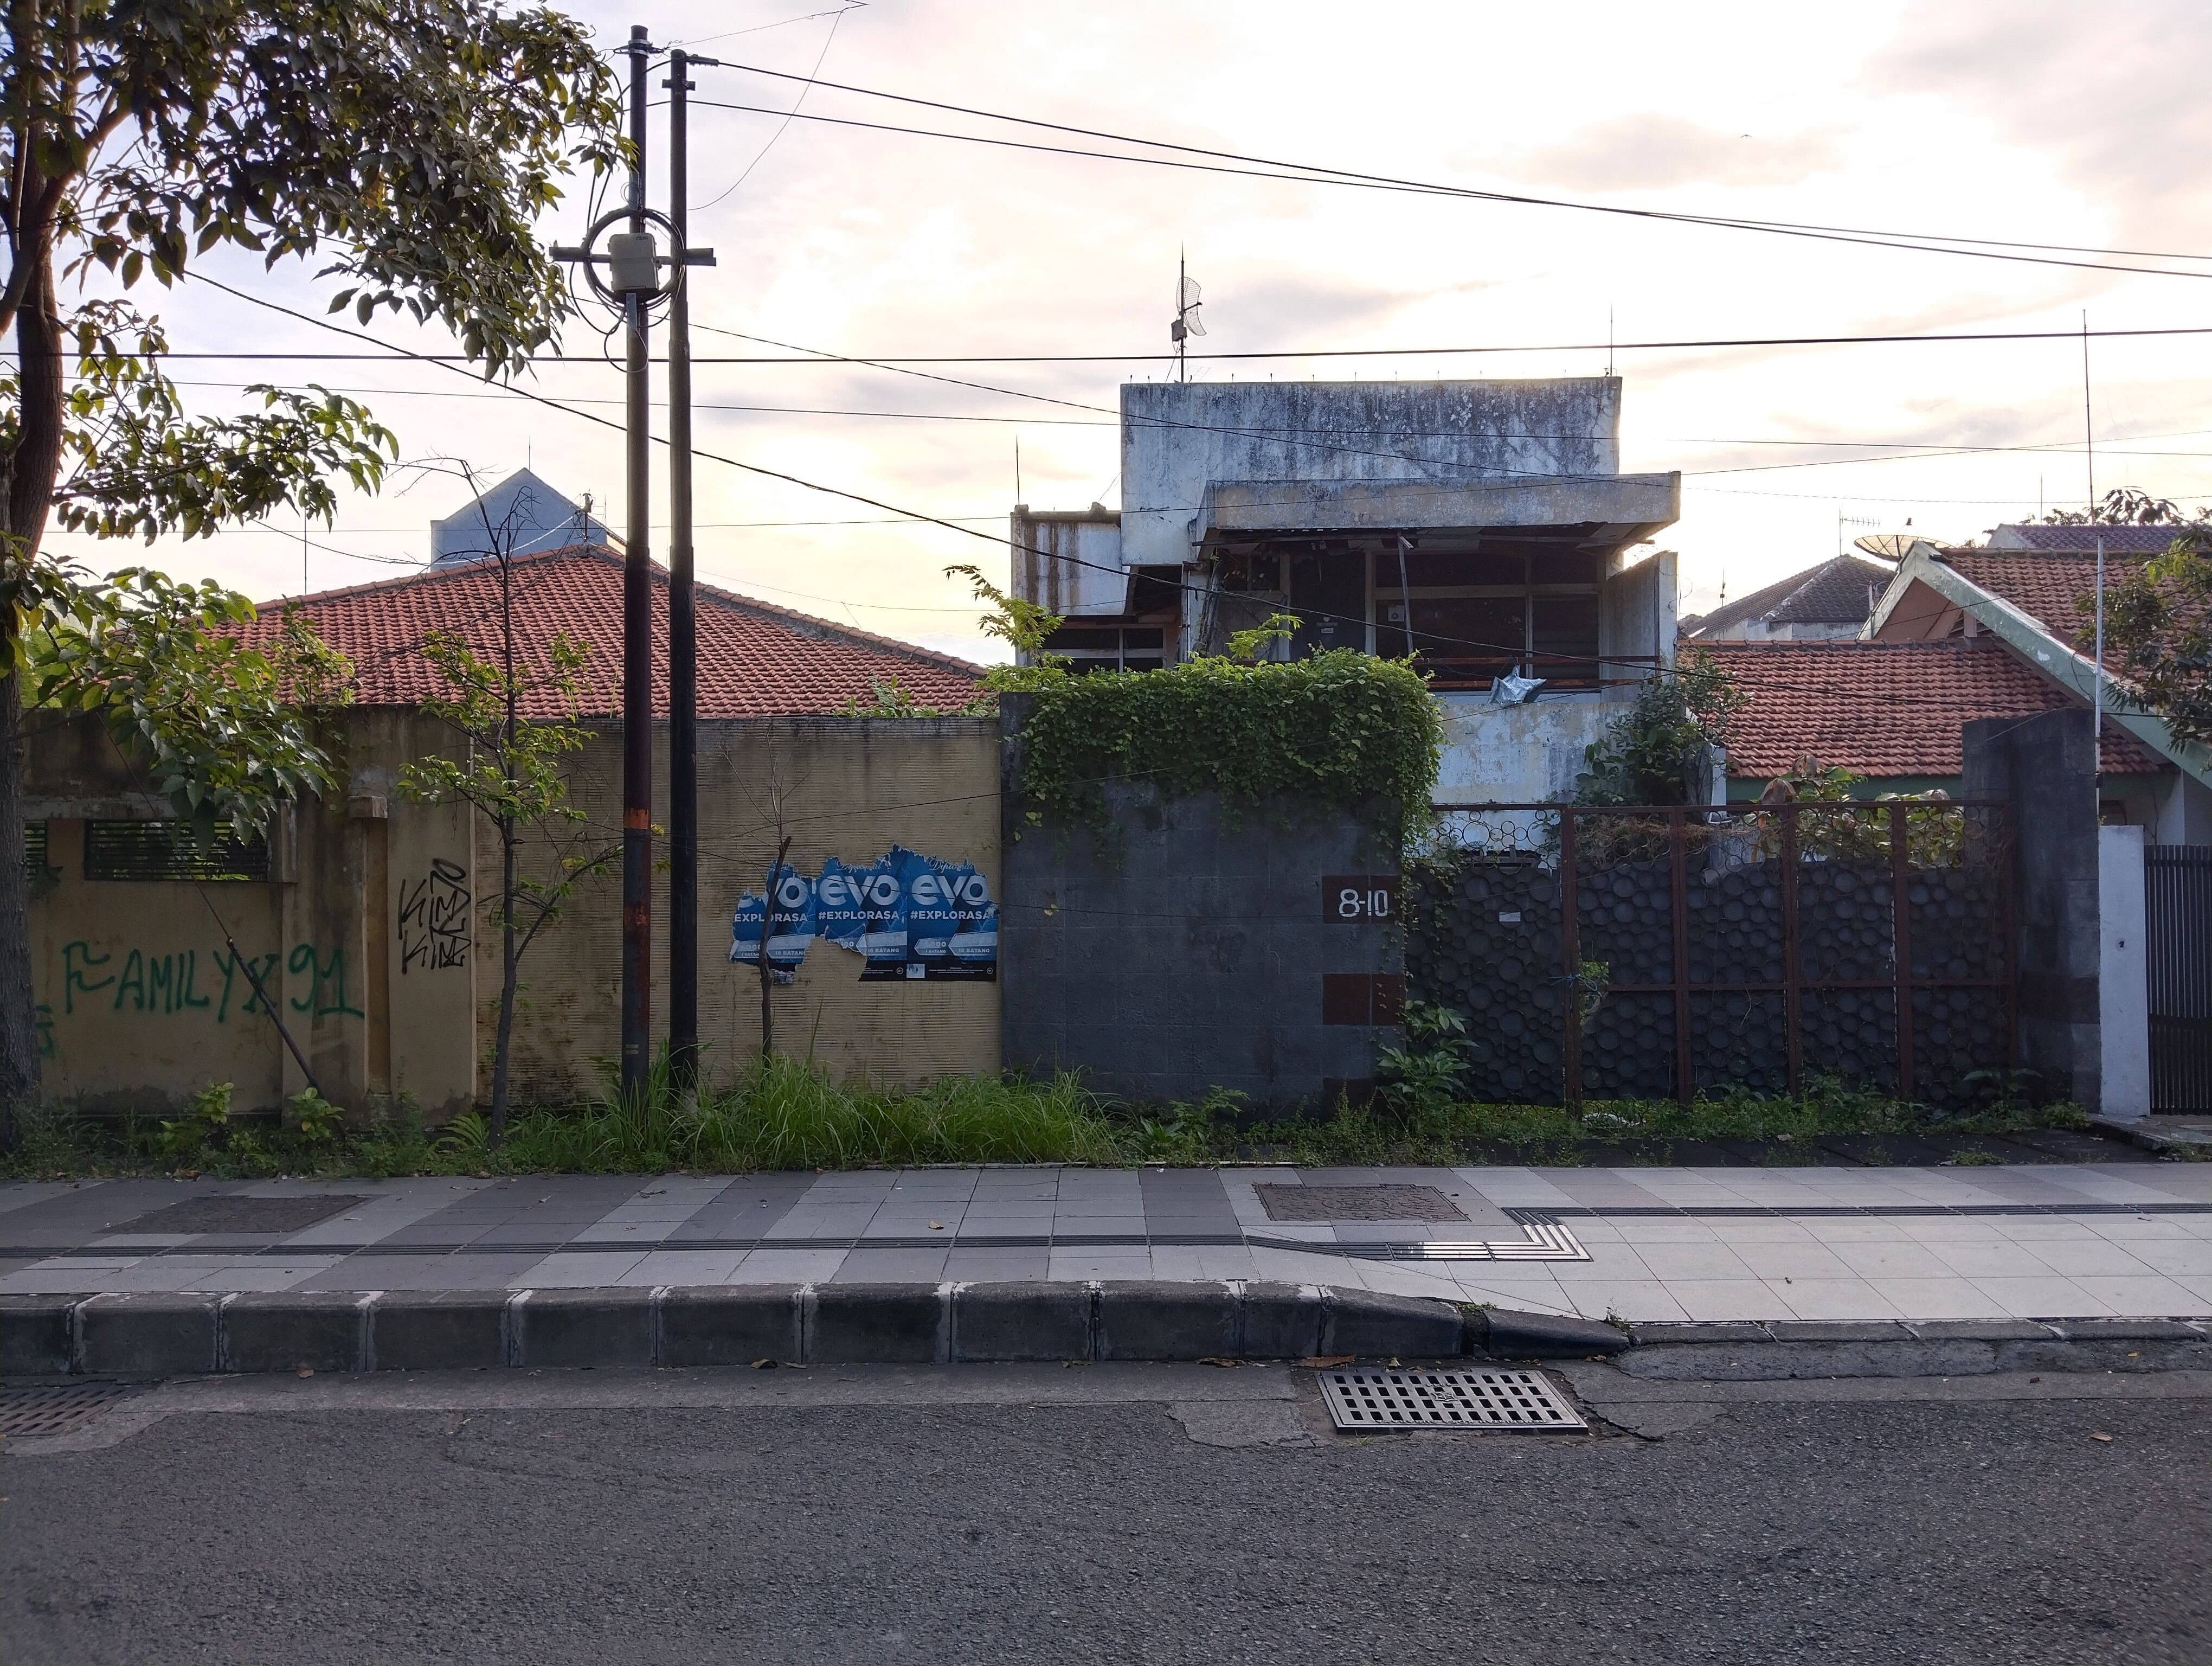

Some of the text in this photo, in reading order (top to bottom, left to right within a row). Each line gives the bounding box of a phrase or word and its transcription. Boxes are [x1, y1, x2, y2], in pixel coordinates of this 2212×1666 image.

[819, 875, 900, 907] evo
[911, 875, 989, 907] evo
[1339, 889, 1388, 917] 8-10
[734, 913, 808, 922] EXPLRASA
[818, 911, 900, 920] #EXPLORASA
